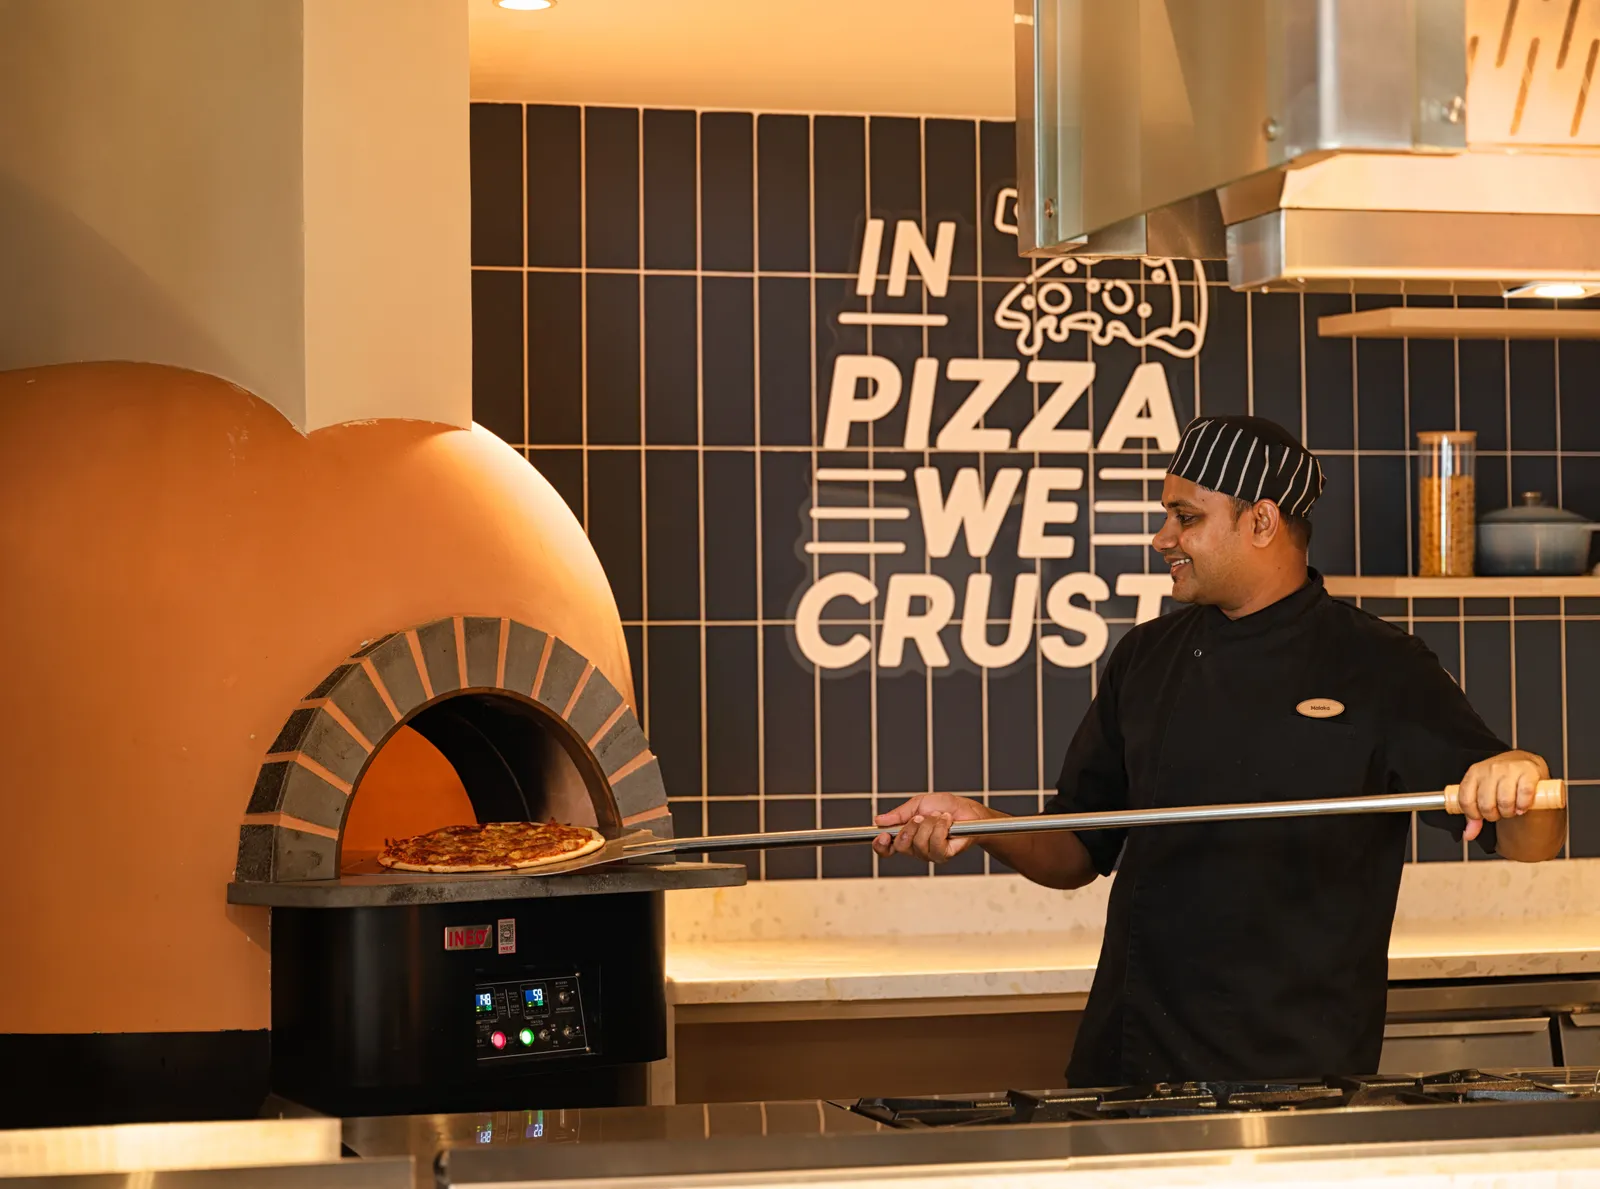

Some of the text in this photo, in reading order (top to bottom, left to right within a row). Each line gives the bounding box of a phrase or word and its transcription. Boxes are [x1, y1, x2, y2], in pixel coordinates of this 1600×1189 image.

[856, 219, 956, 297] IN
[823, 355, 1181, 452] PIZZA
[914, 467, 1083, 559] WE
[532, 988, 543, 1001] 59
